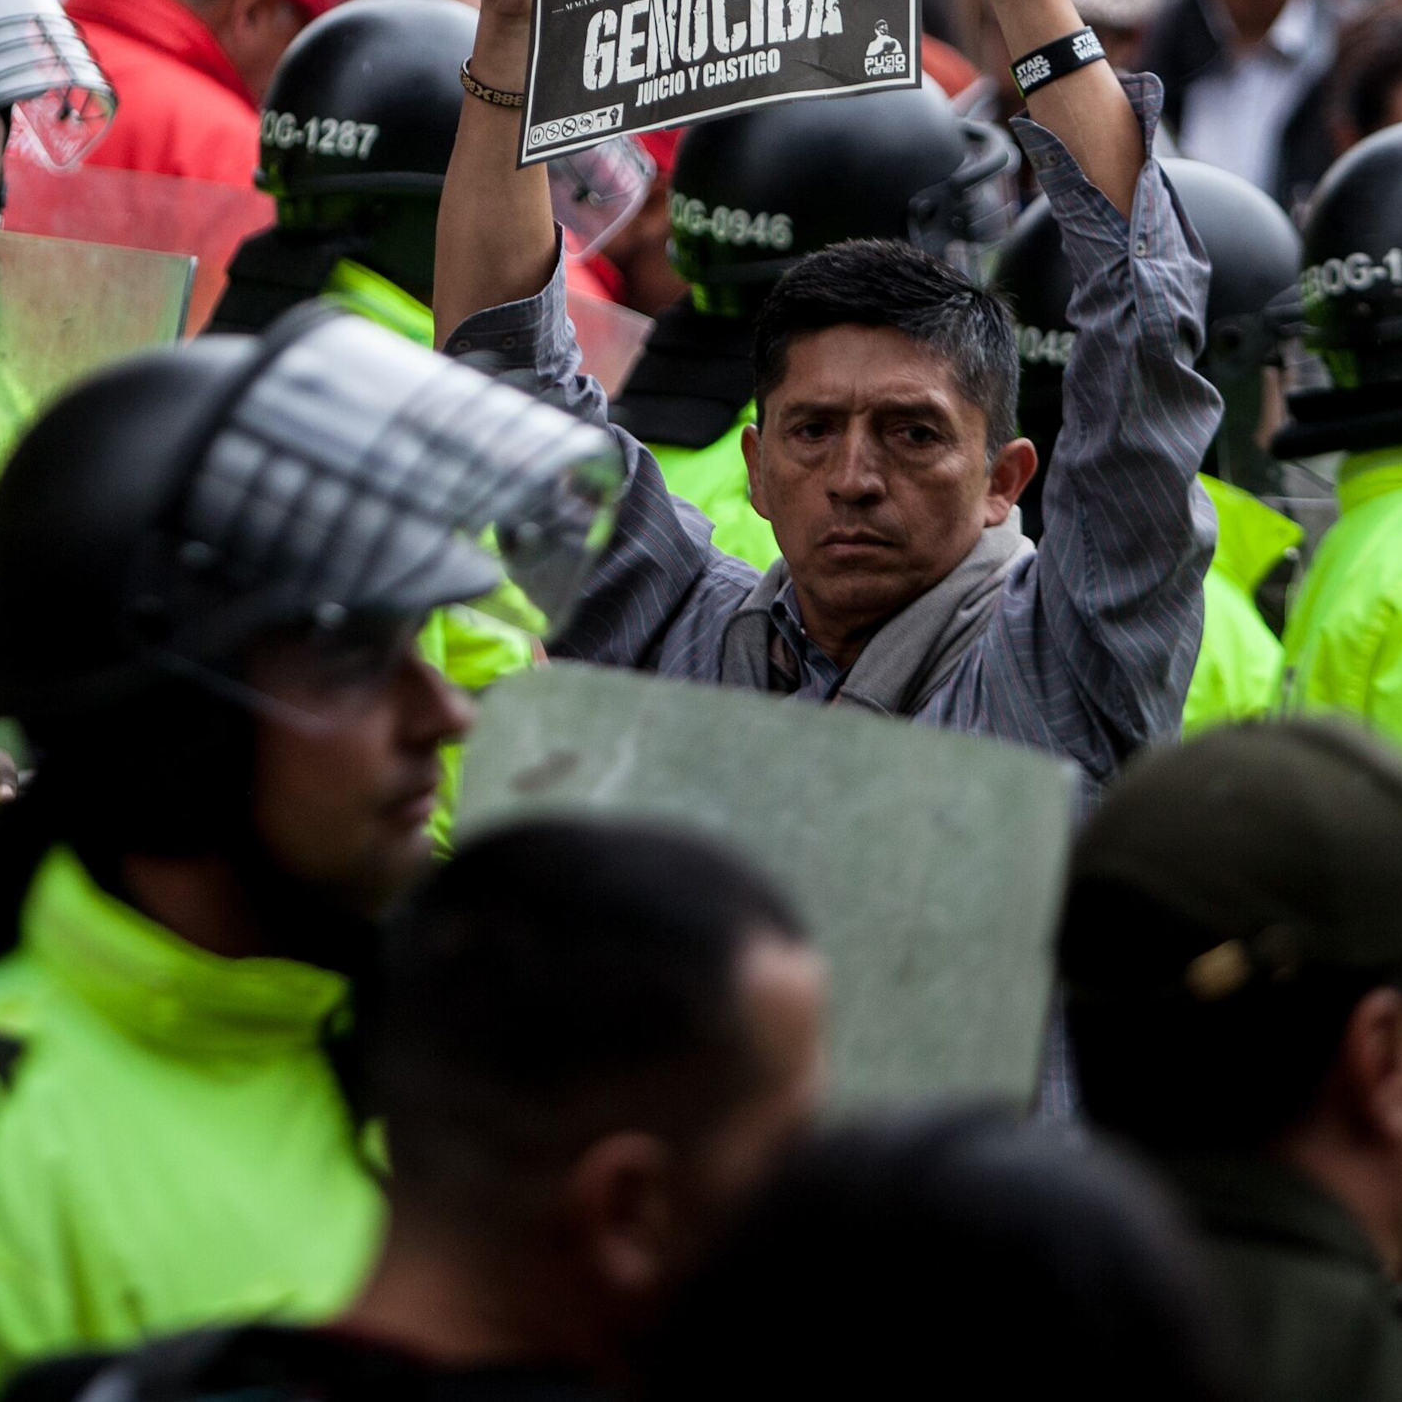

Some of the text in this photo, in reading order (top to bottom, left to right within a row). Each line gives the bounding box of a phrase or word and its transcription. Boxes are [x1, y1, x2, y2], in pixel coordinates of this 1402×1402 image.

[636, 48, 780, 107] JUICIO Y CASTIGO
[1015, 54, 1049, 79] STAR
[1018, 64, 1051, 89] WARS
